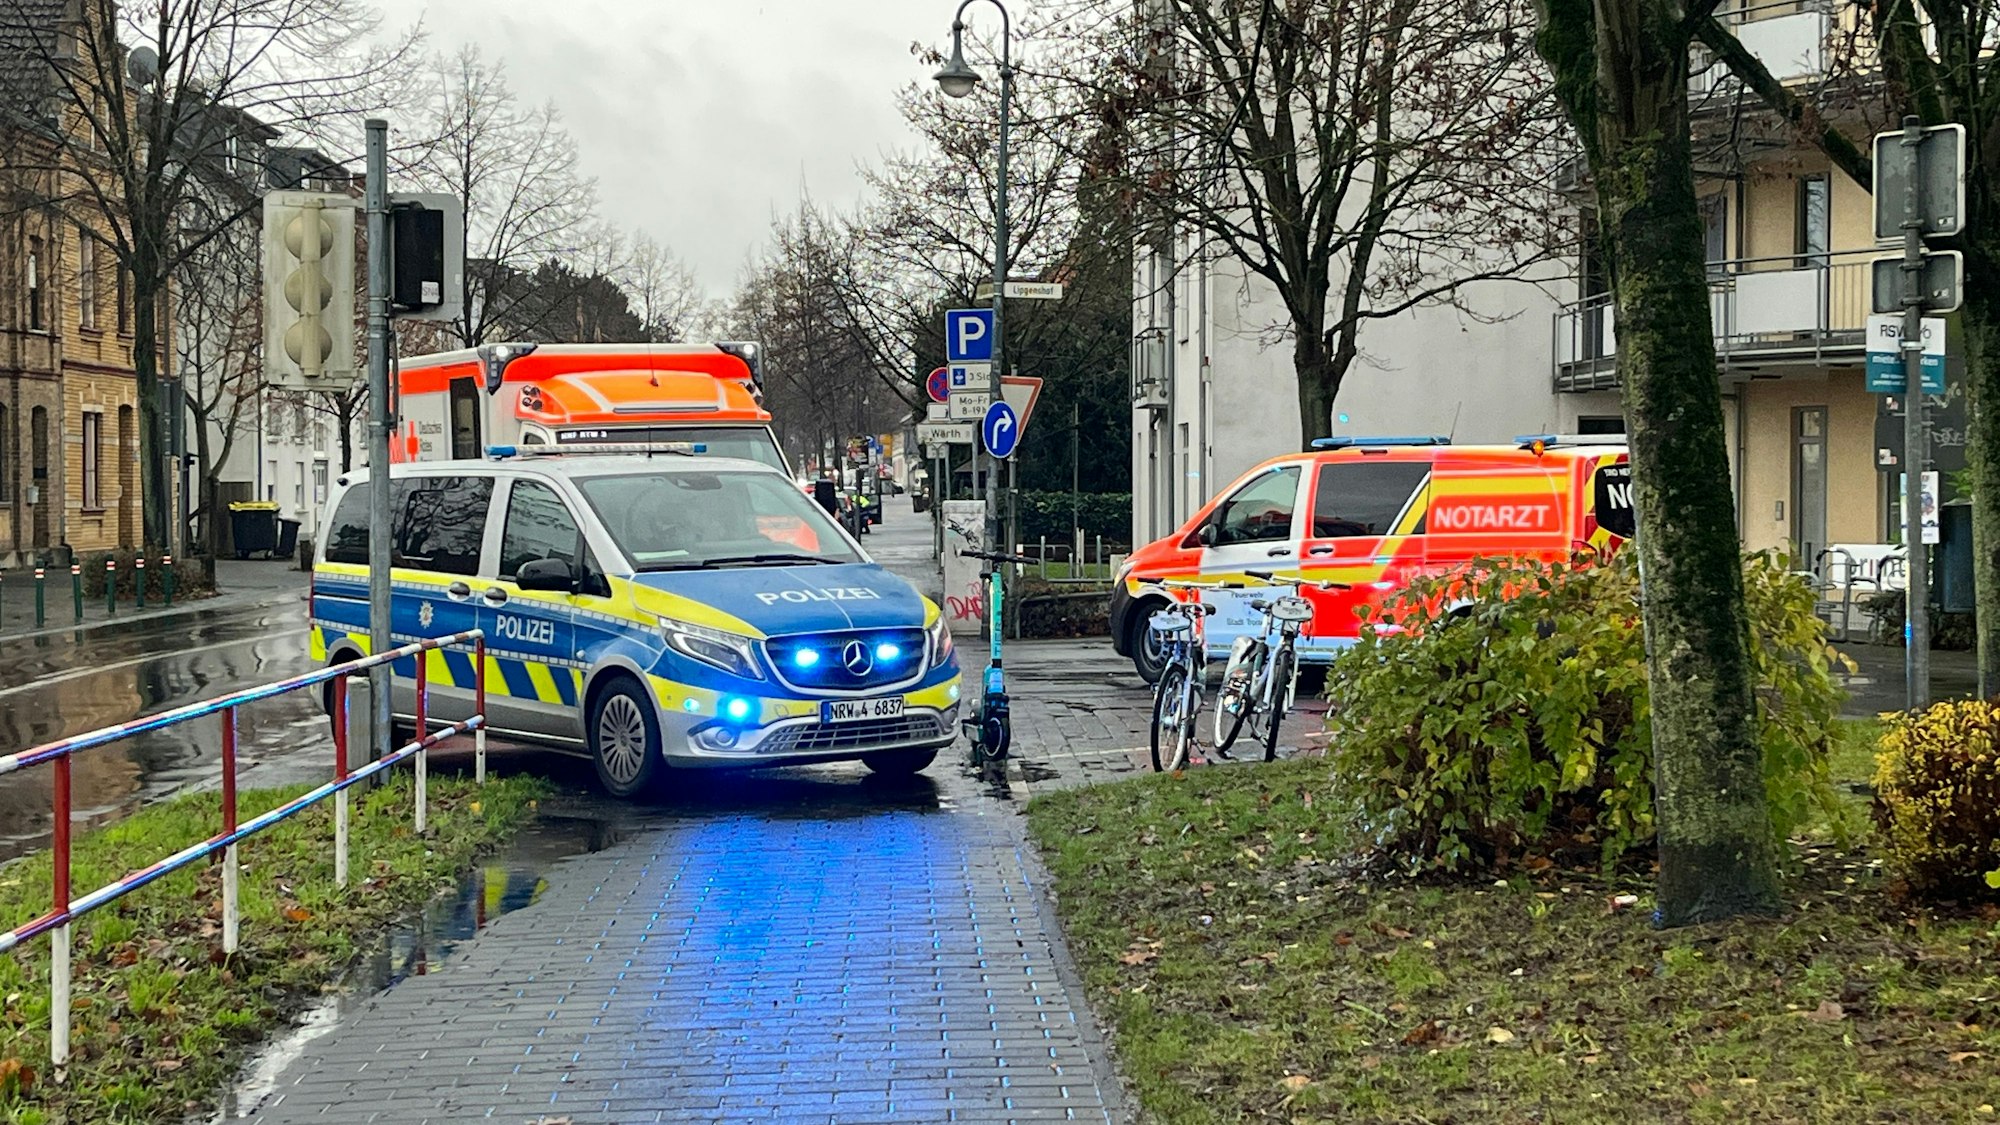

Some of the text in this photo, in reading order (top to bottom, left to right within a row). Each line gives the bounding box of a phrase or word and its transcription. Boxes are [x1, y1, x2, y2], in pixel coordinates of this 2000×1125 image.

[958, 317, 986, 355] P
[1434, 505, 1550, 528] NOTARZT
[755, 587, 882, 605] POLIZEI
[495, 614, 554, 645] POLIZEI
[830, 703, 855, 719] NRW
